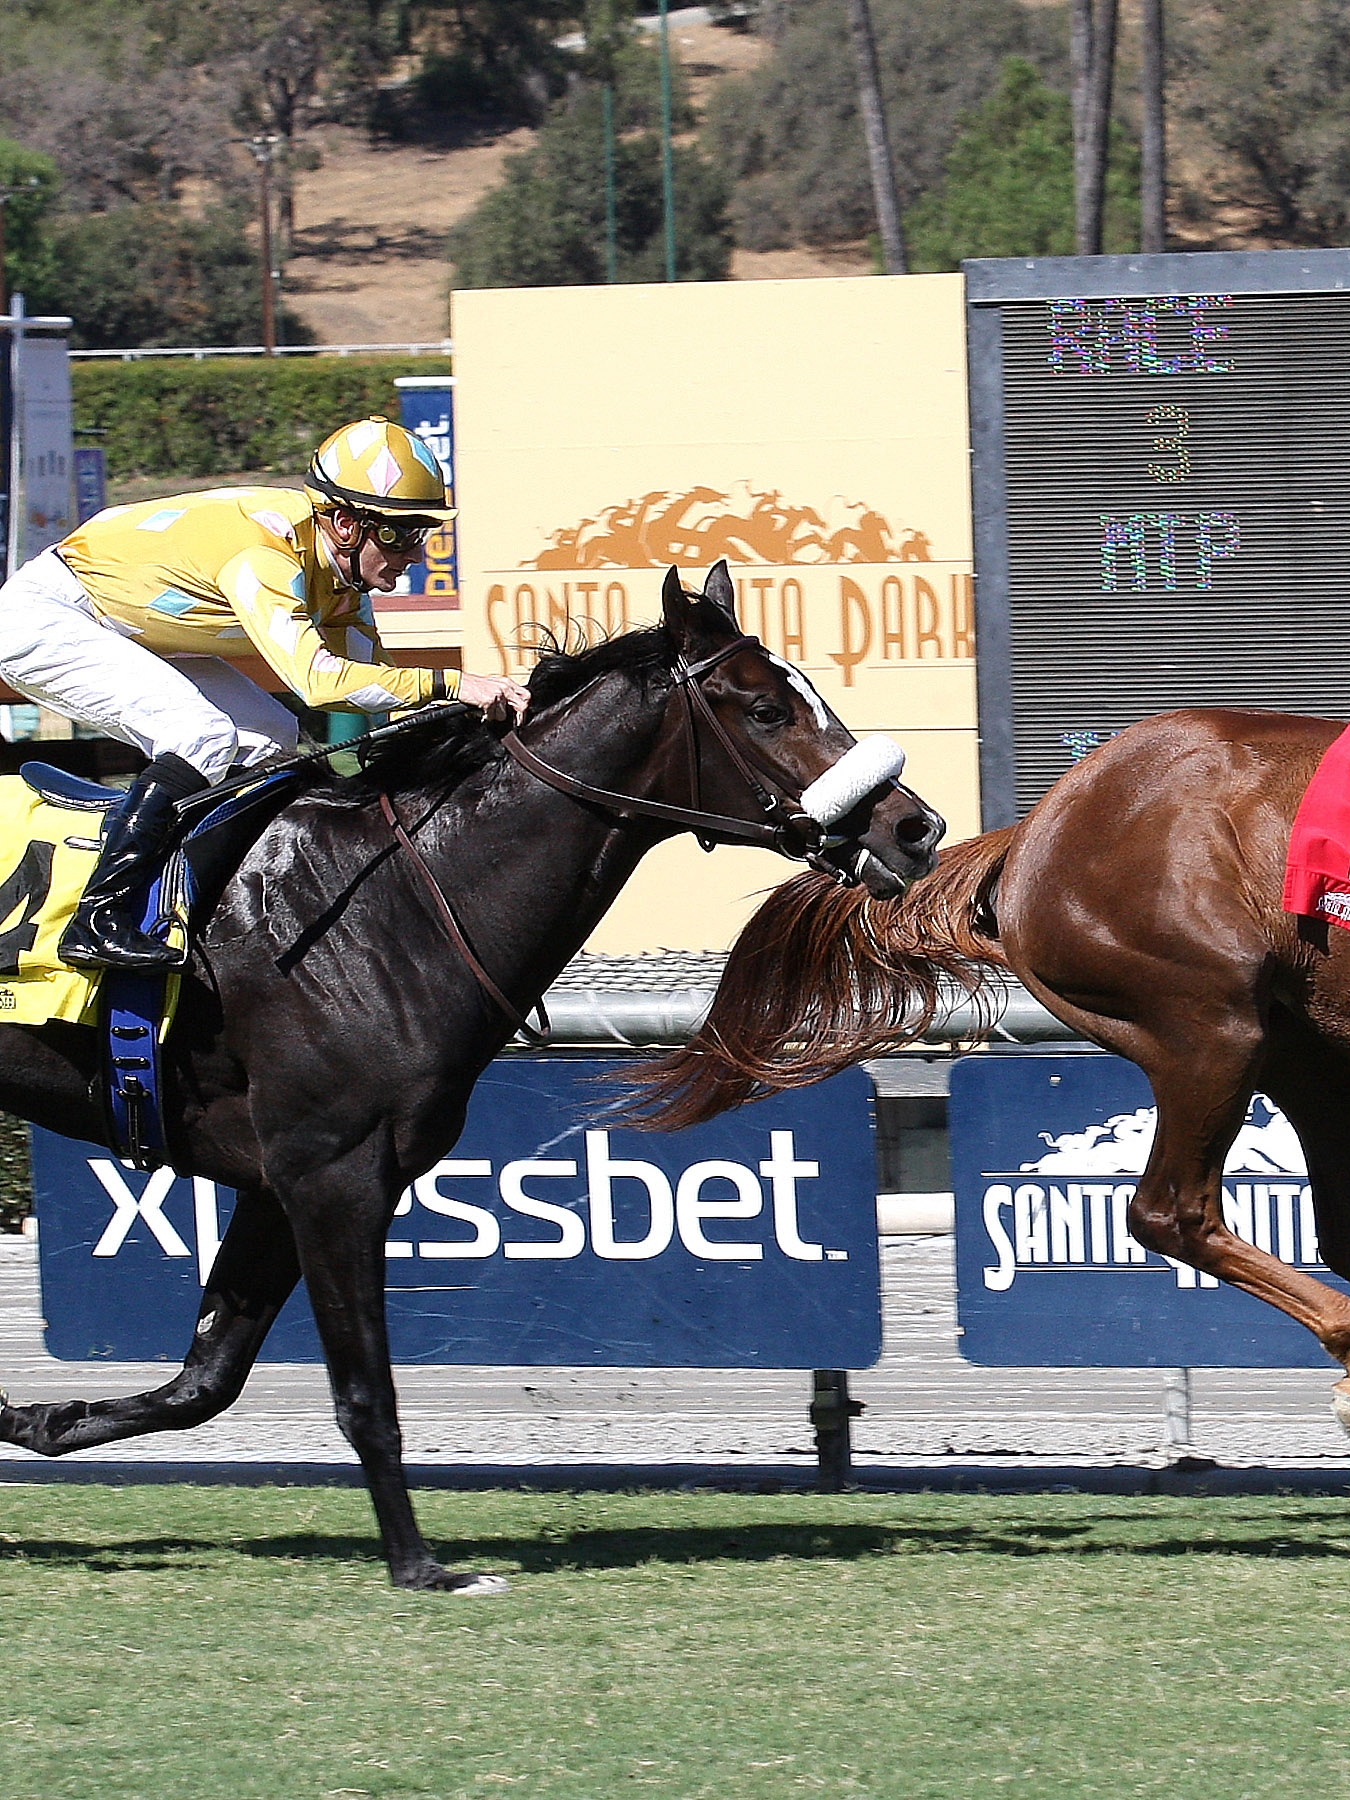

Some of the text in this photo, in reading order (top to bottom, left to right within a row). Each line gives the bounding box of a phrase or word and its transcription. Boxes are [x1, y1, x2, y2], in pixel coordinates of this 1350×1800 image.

[1047, 294, 1236, 374] RACE
[1145, 404, 1191, 483] 3
[1099, 511, 1241, 591] MTP
[826, 574, 976, 688] PARK
[86, 1129, 825, 1287] xssbet
[983, 1183, 1148, 1292] SANTA
[1163, 1183, 1327, 1289] NITA
